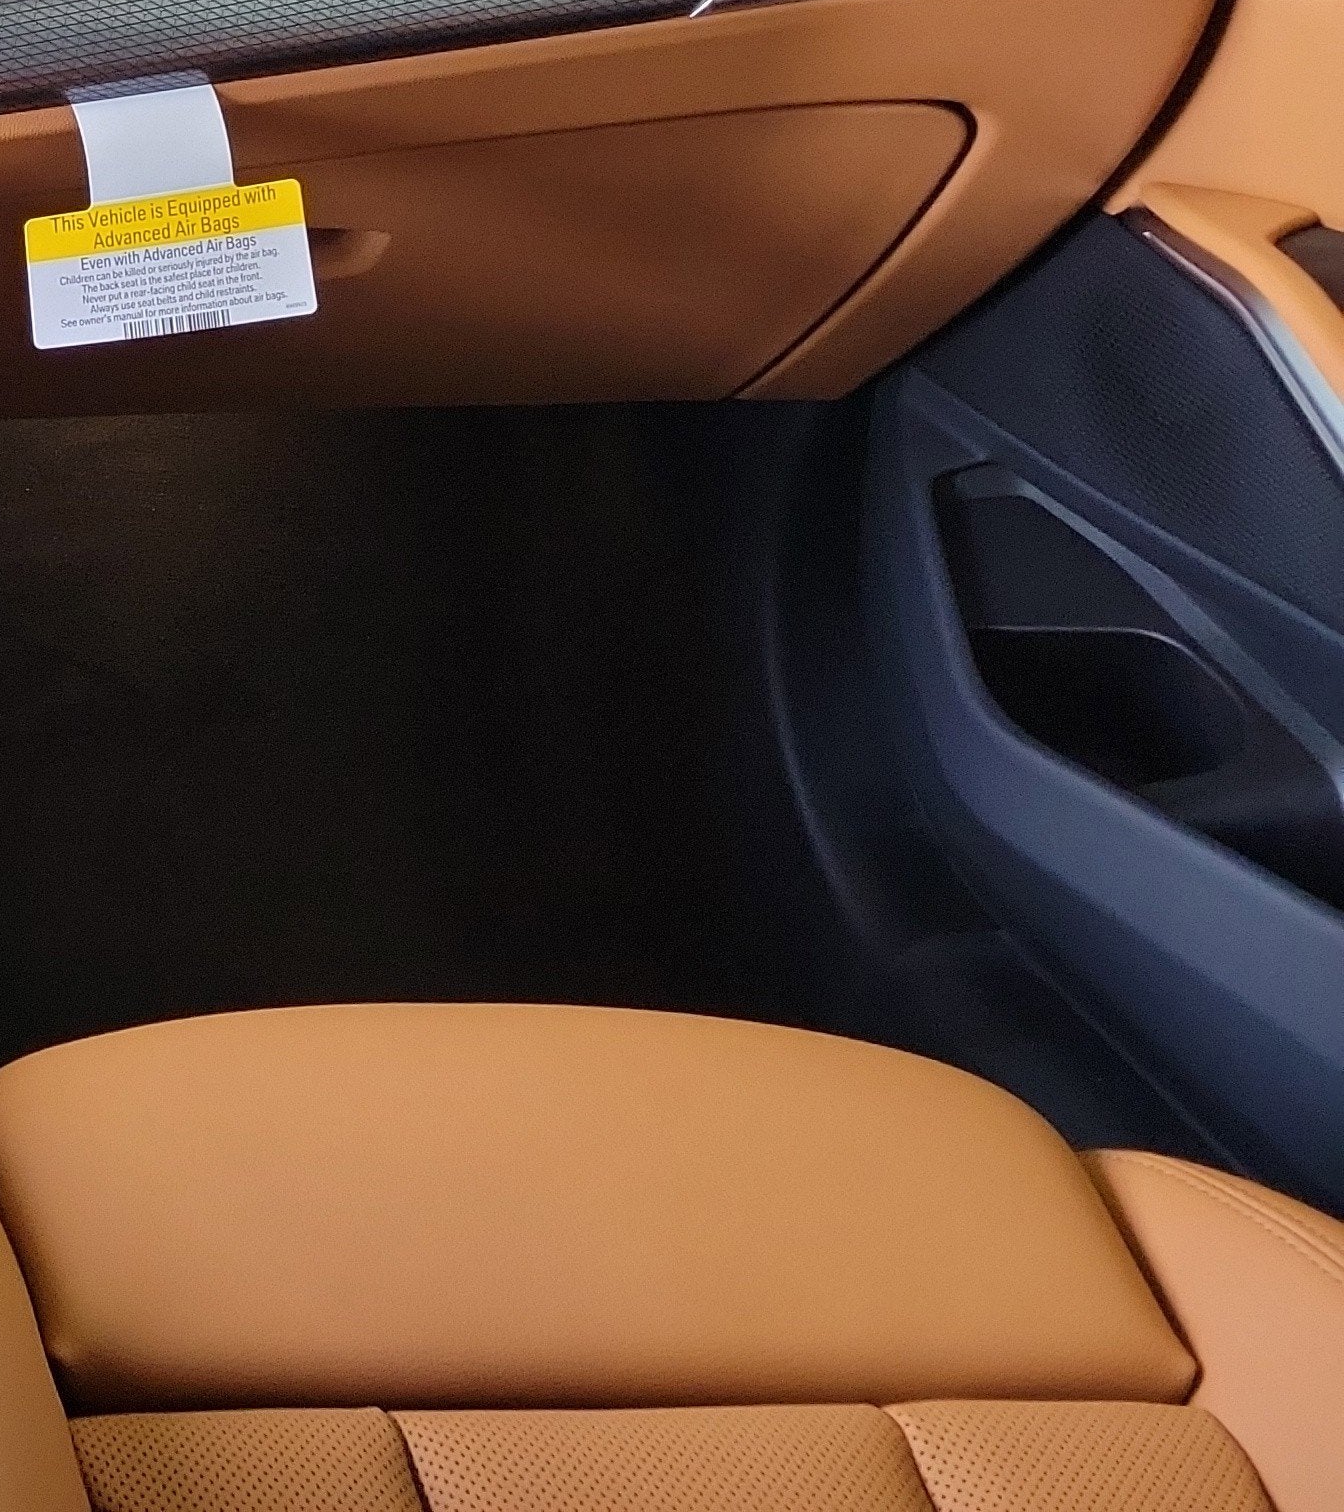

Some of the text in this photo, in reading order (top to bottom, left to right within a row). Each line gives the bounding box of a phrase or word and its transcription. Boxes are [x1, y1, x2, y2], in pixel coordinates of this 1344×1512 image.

[50, 185, 277, 234] This Vehicle is Equipped with
[93, 216, 240, 250] Advanced Air Bags
[59, 273, 95, 286] Children
[96, 273, 111, 282] can
[113, 270, 123, 279] be
[124, 266, 146, 278] killed
[158, 259, 194, 274] seriously
[195, 254, 223, 269] injured
[224, 253, 234, 265] by
[236, 251, 249, 261] the
[250, 249, 261, 259] air
[262, 247, 280, 258] bag.
[81, 236, 257, 271] Even with Advanced Air Bags
[82, 284, 98, 294] The
[99, 280, 119, 291] back
[121, 278, 139, 288] seat
[148, 275, 162, 285] the
[163, 271, 189, 283] safest
[190, 268, 211, 282] place
[213, 265, 224, 276] for
[226, 262, 261, 274] children.
[82, 294, 107, 305] Never
[108, 291, 122, 303] put
[130, 284, 175, 300] rear-facing
[177, 280, 196, 292] child
[198, 277, 215, 289] seat
[225, 274, 239, 285] the
[240, 271, 263, 283] front.
[60, 289, 289, 329] See owner's manual for more information about air bags.
[90, 284, 257, 315] Always use seat belts and child restraints.
